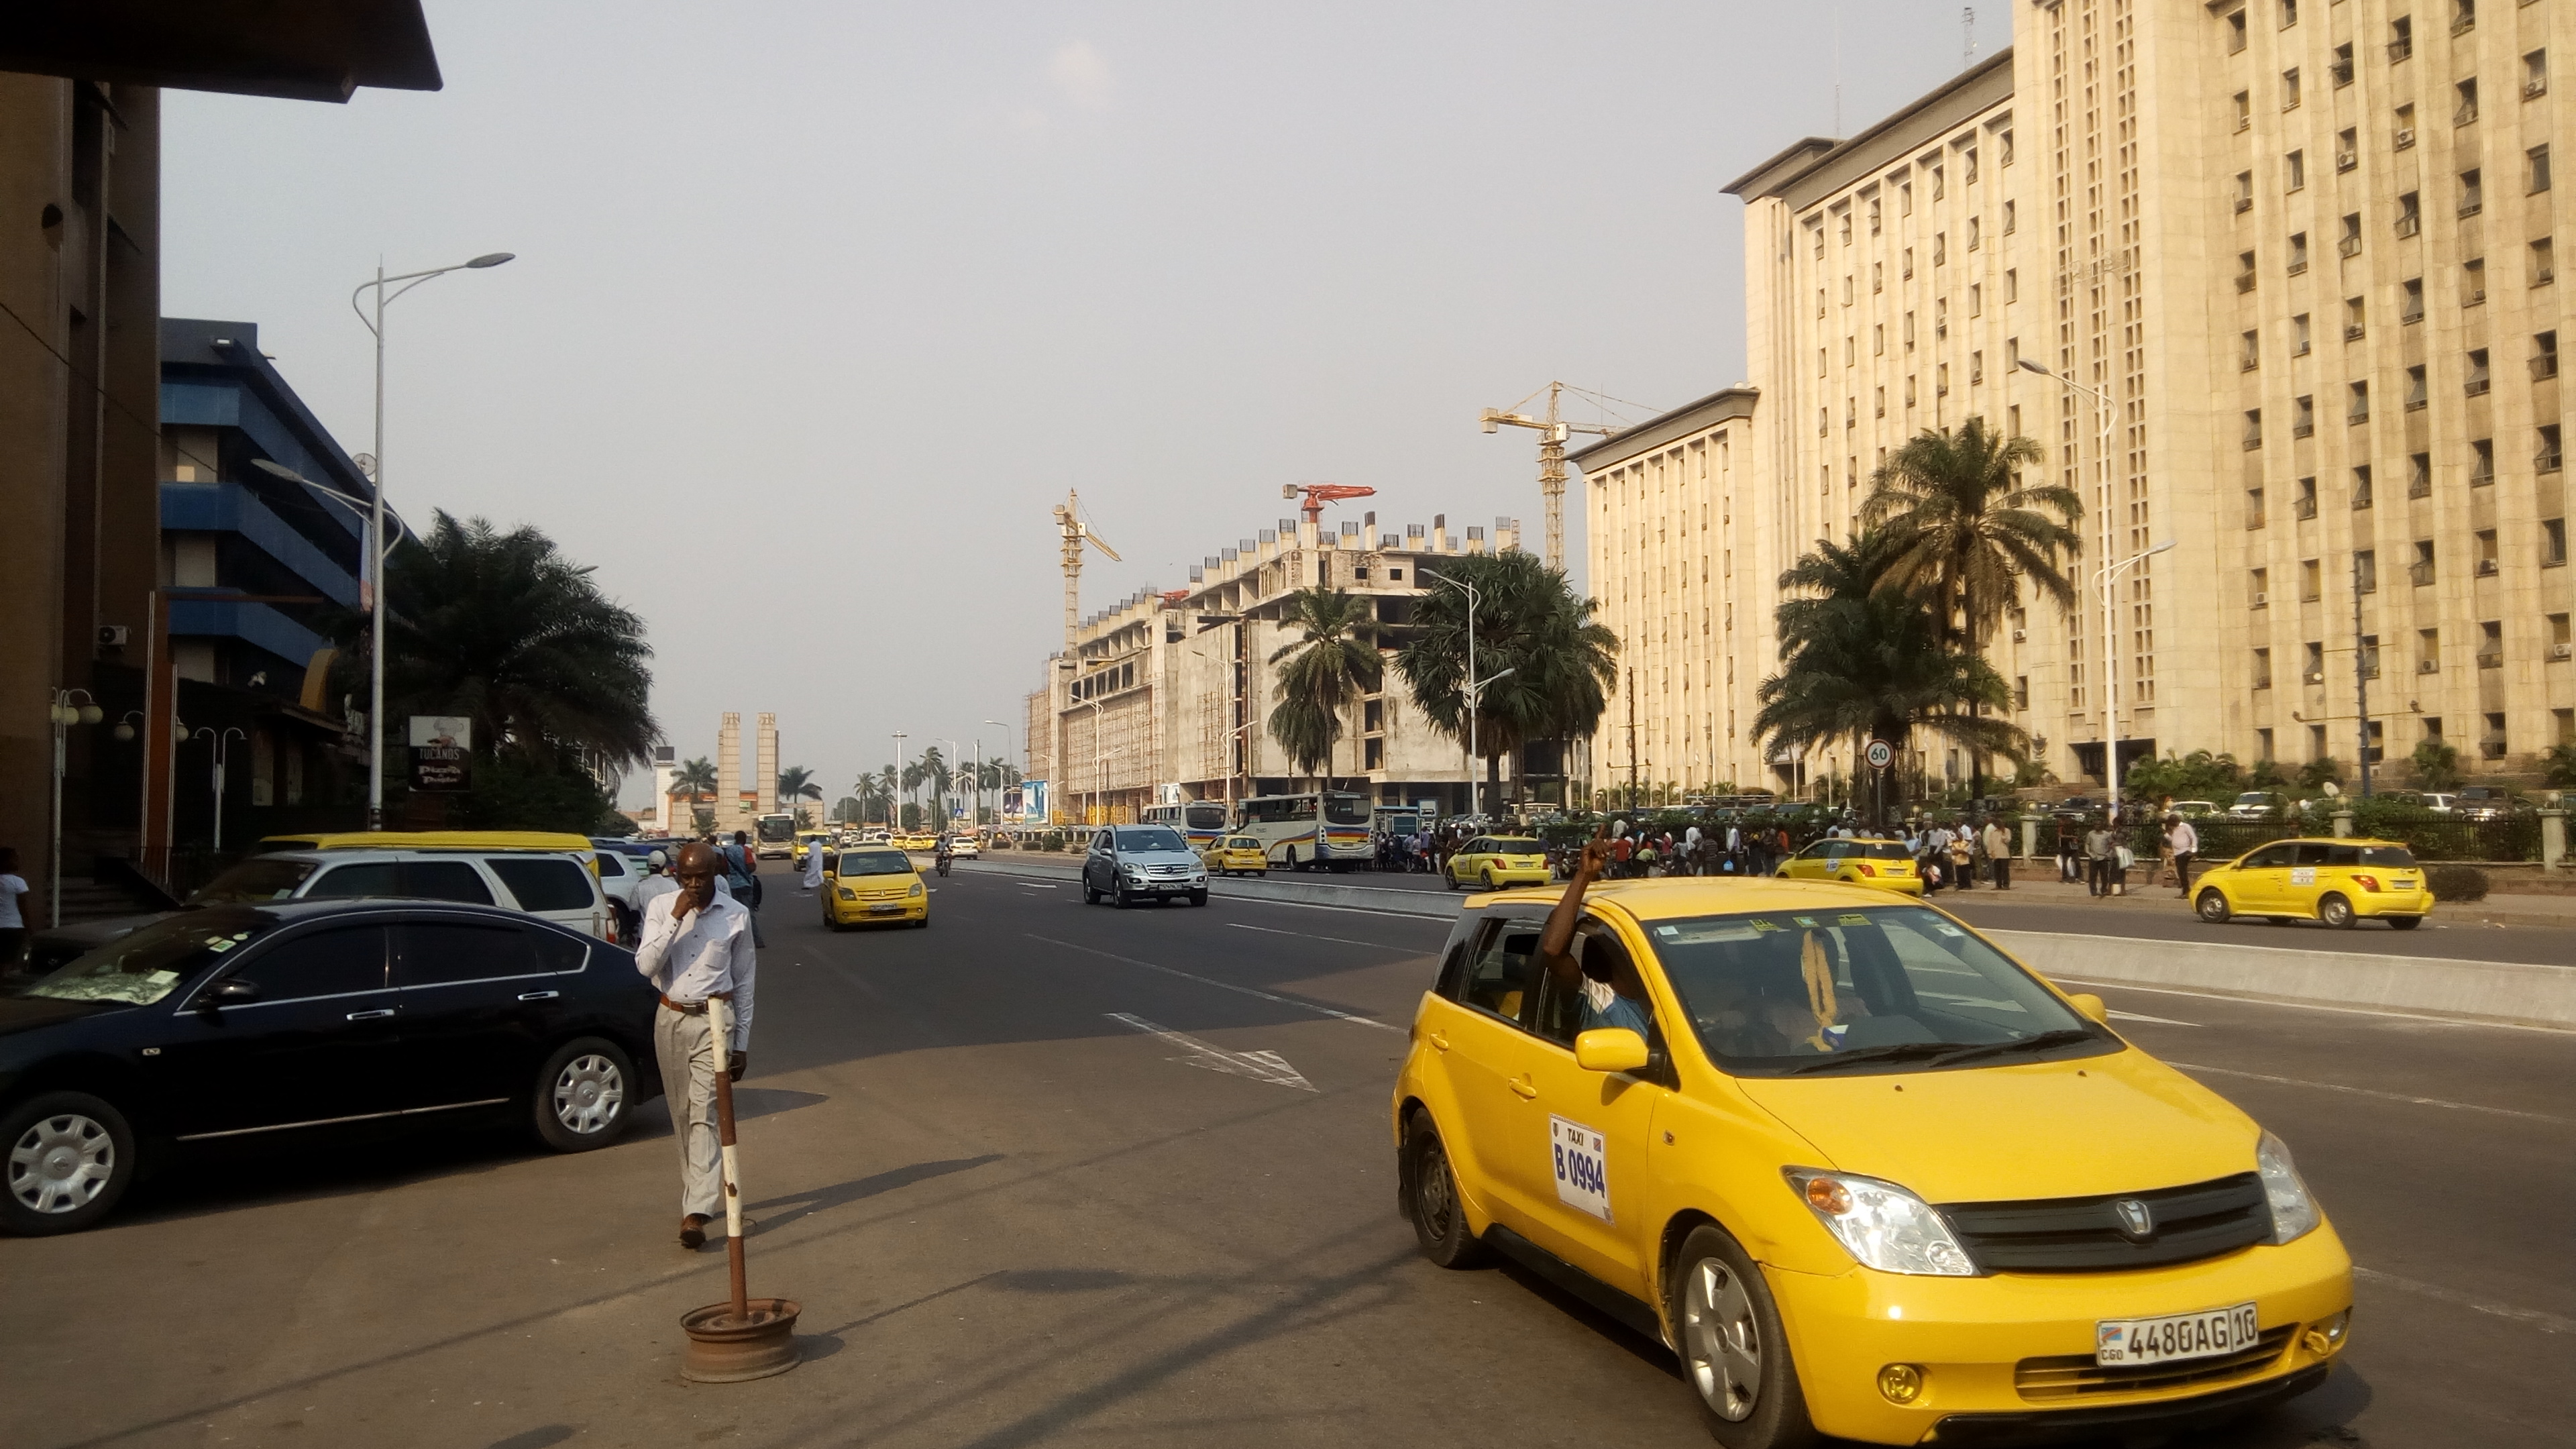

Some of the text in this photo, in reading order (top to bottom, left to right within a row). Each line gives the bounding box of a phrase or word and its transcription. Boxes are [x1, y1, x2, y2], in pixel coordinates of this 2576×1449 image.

[419, 748, 460, 760] TUCANOS
[1871, 748, 1888, 760] 60
[1567, 1128, 1585, 1146] TAXI
[1554, 1142, 1605, 1199] B 0994
[2100, 1348, 2124, 1361] CGO
